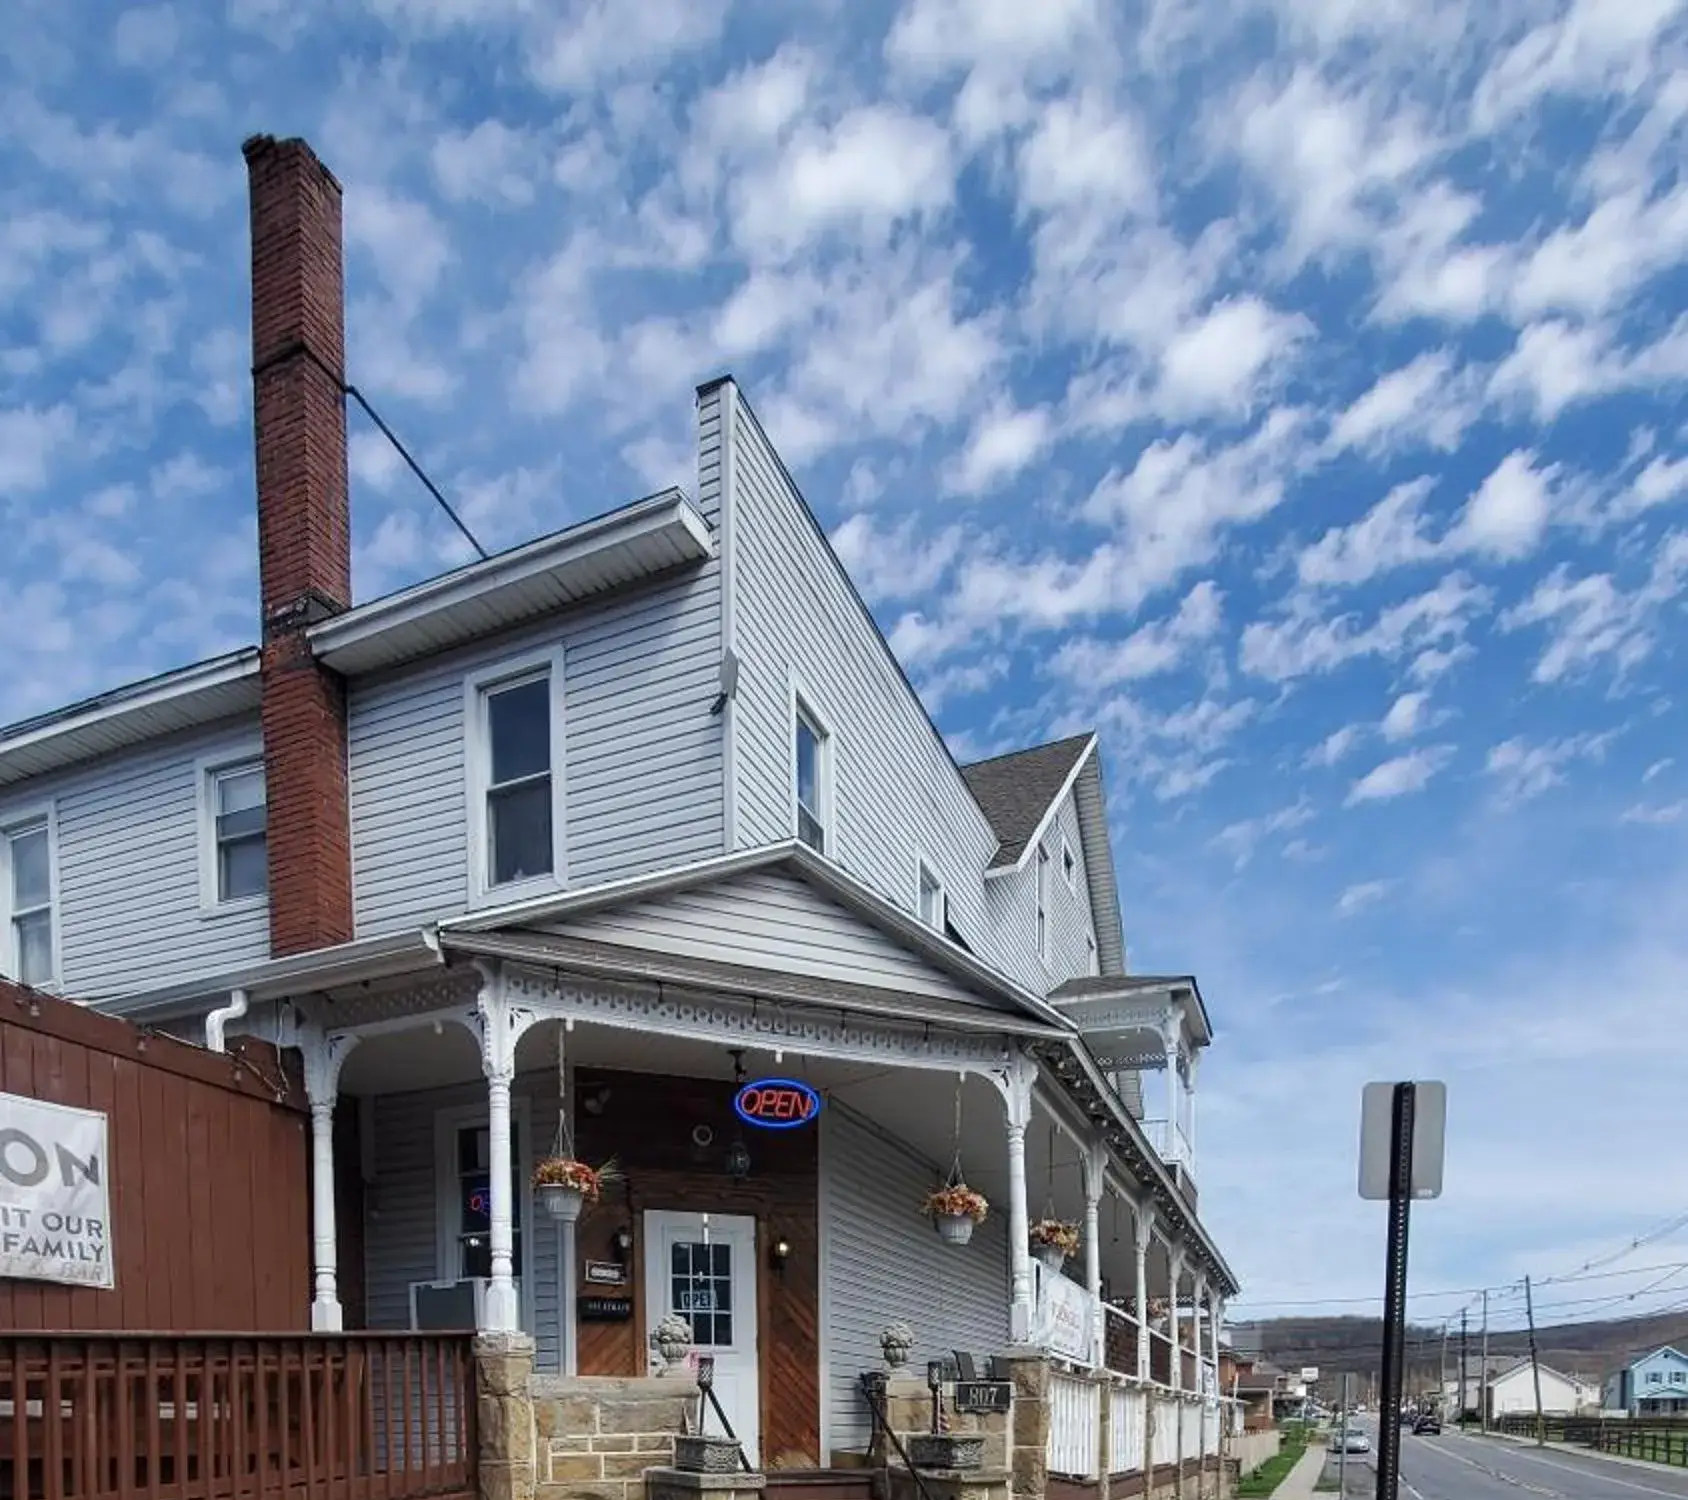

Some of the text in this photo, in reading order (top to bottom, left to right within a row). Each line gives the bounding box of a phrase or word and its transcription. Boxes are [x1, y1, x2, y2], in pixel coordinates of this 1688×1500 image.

[740, 1089, 812, 1118] OPEN
[0, 1128, 99, 1187] ON
[41, 1212, 103, 1239] OUR
[3, 1232, 104, 1262] FAMILY
[970, 1387, 998, 1406] 807
